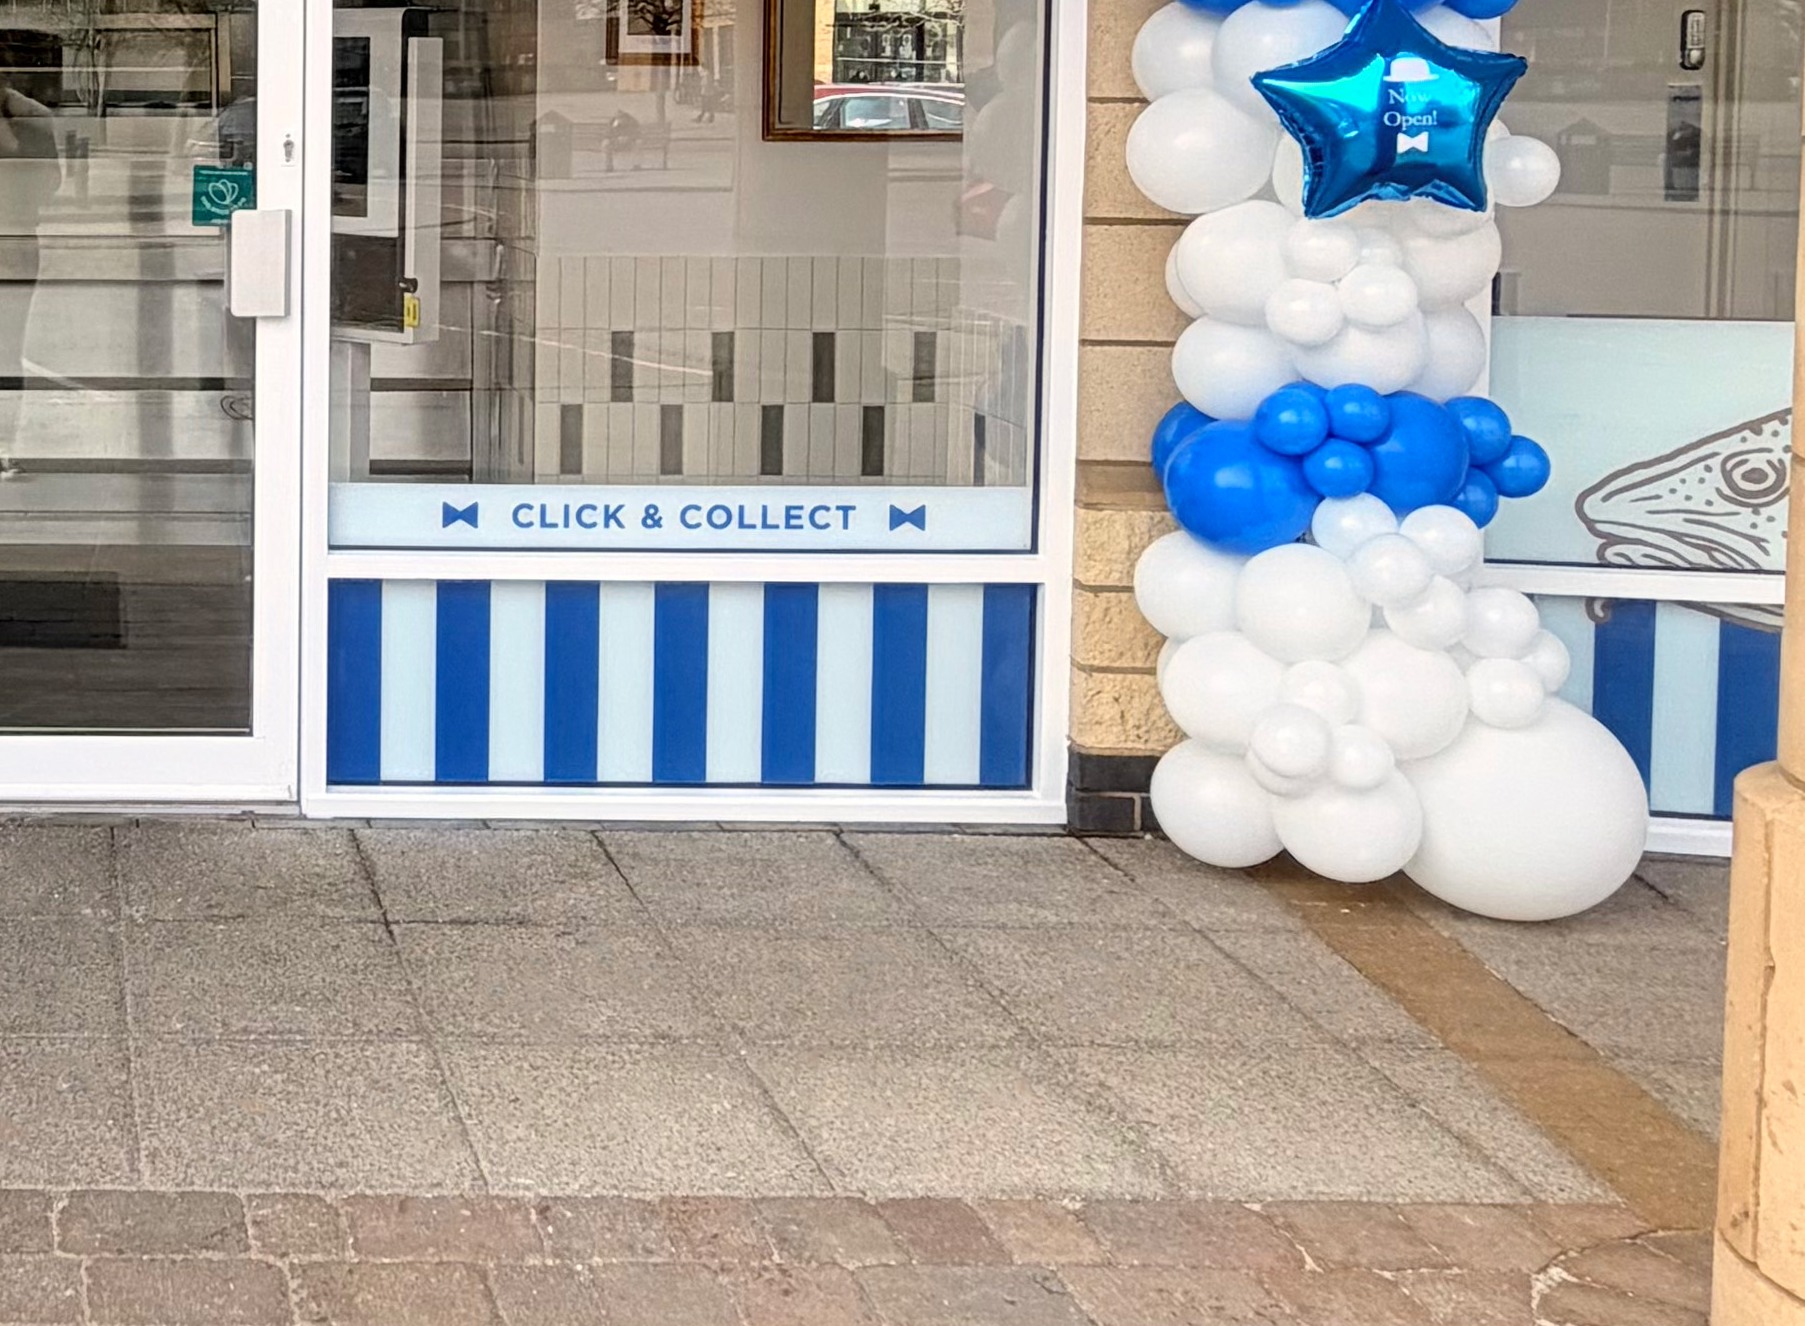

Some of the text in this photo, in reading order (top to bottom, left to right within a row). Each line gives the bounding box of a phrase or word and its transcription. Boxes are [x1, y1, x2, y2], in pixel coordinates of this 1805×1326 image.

[1383, 109, 1438, 131] Open!
[512, 503, 857, 530] CLICK & COLLECT
